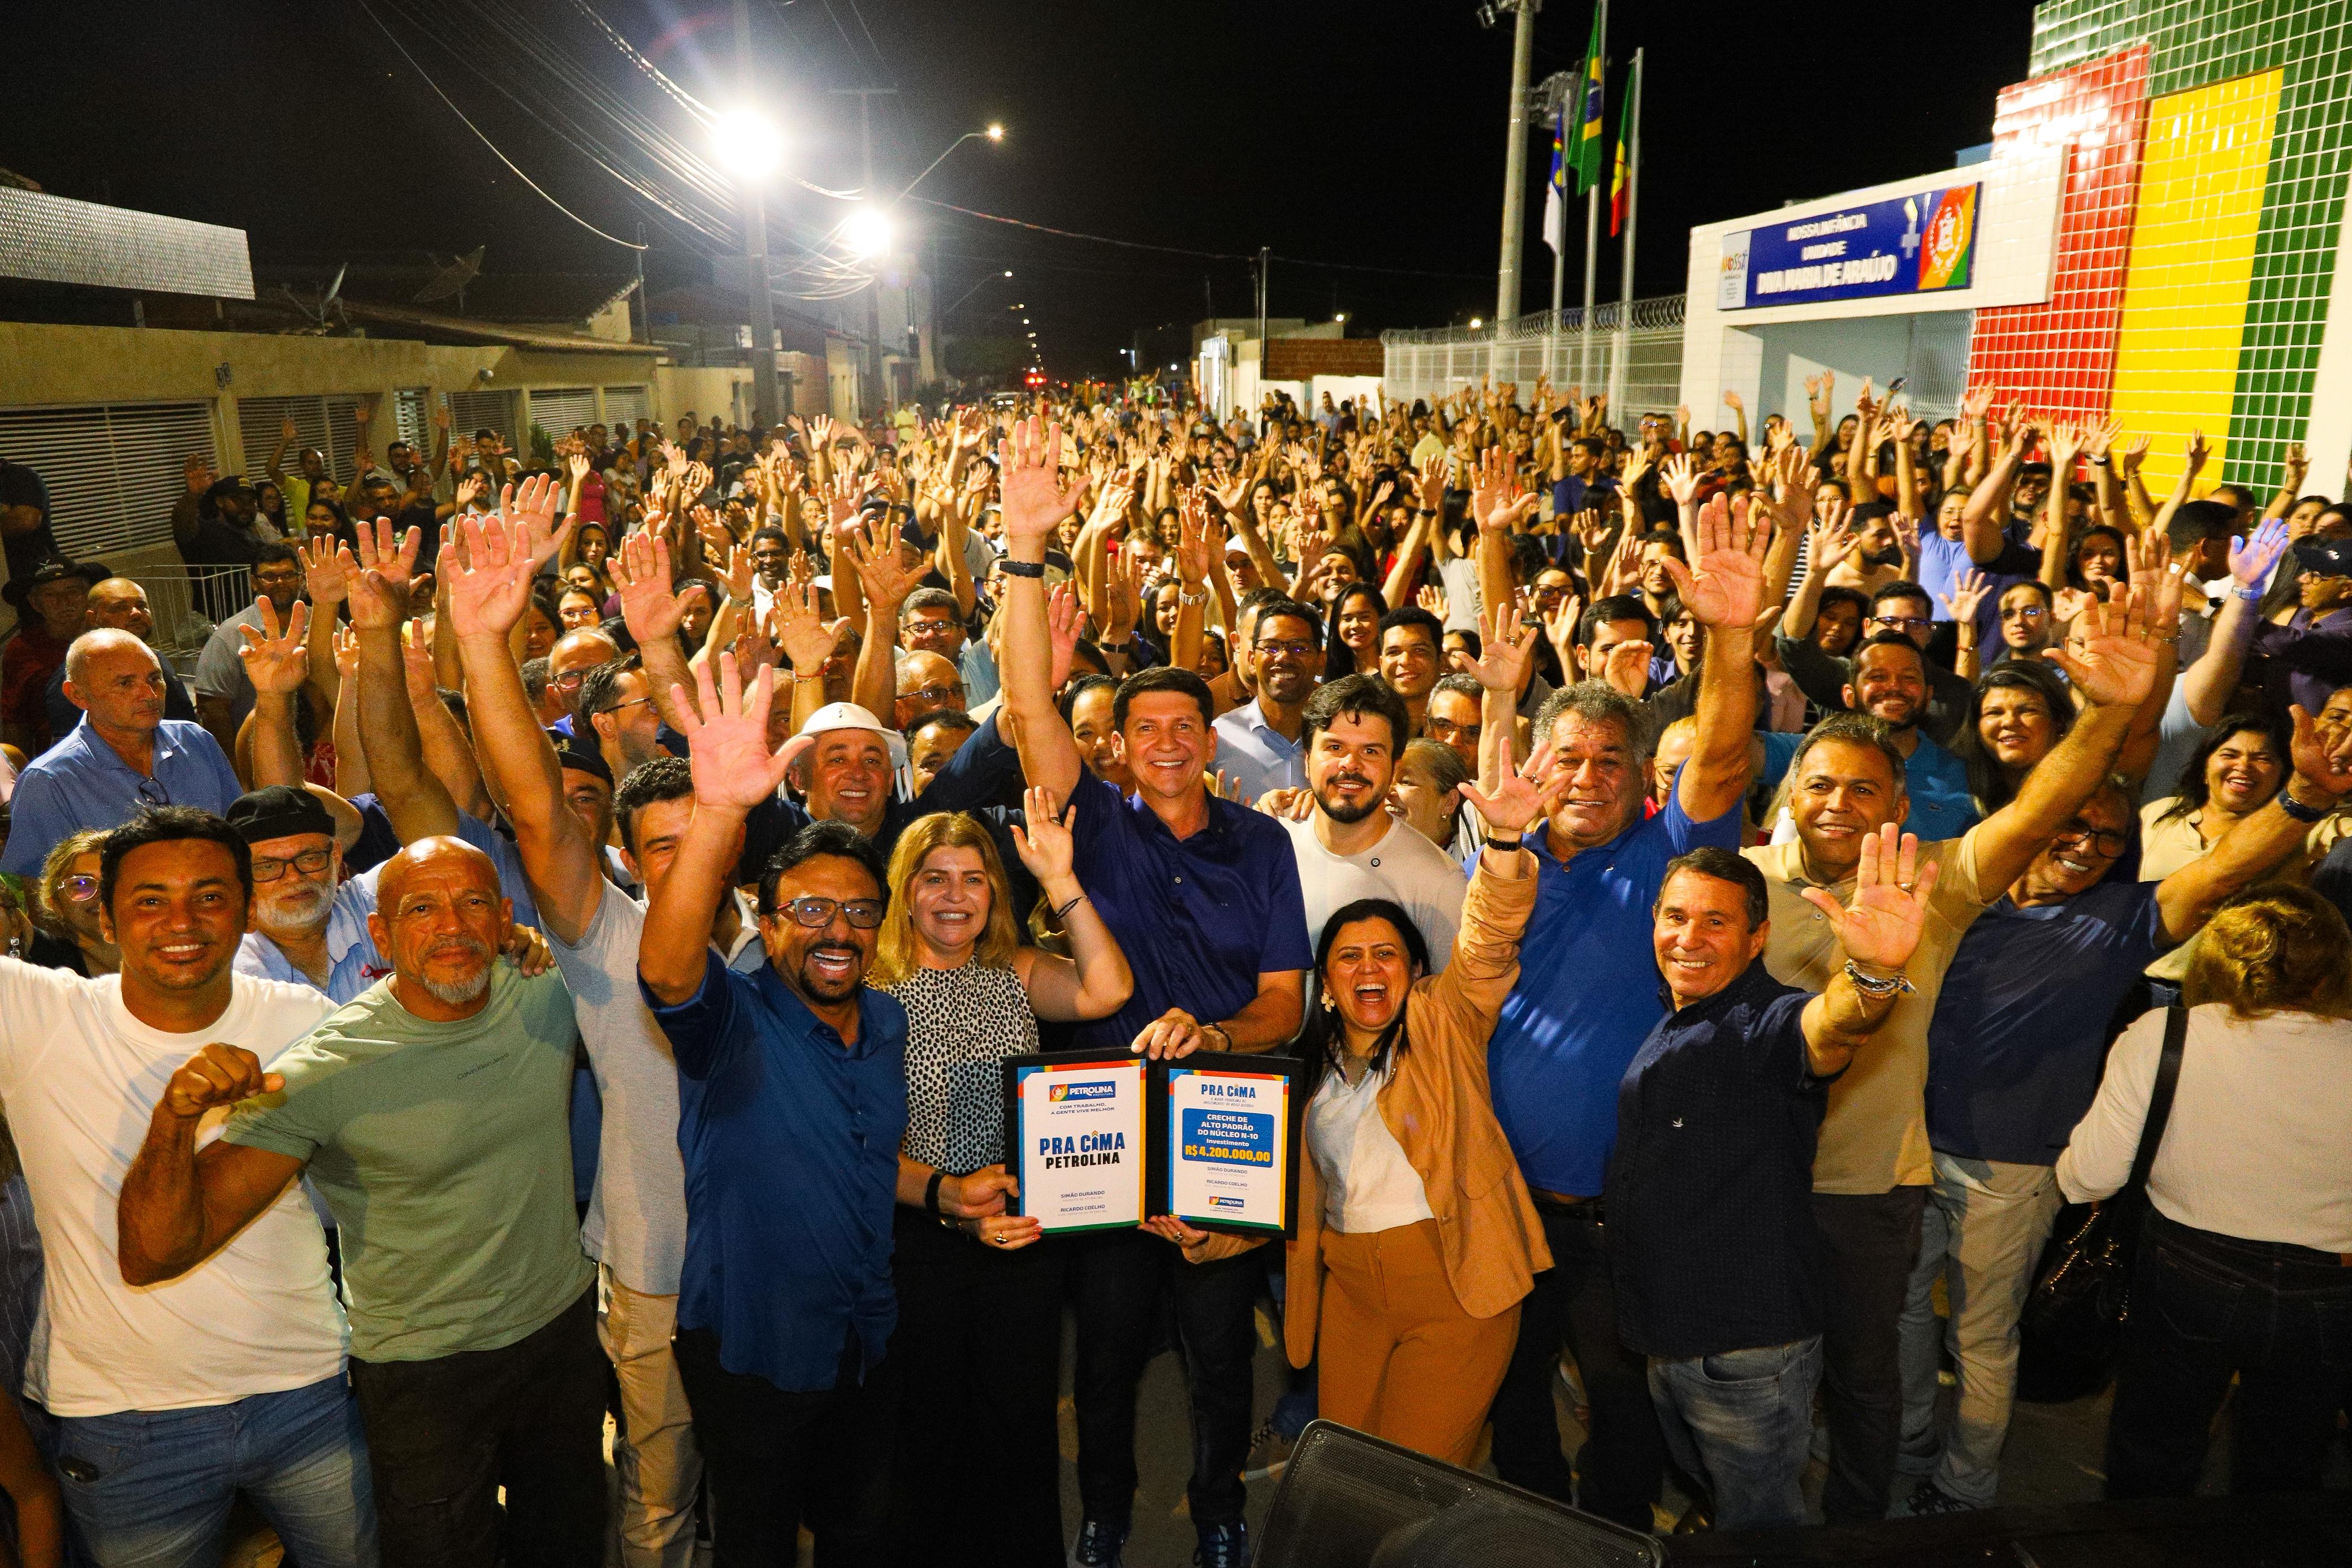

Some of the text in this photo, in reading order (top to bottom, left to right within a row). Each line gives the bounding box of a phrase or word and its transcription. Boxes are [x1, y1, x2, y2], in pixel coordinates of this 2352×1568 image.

[1787, 213, 1867, 241] NOSSA INFÂNCIA
[1801, 240, 1848, 261] UNIDADE
[1757, 270, 1785, 295] DIVA
[1784, 265, 1824, 291] MARIA
[1823, 262, 1843, 287] DE
[1841, 250, 1898, 285] ARAÚJO
[1070, 1086, 1113, 1096] PETROLINA
[1201, 1084, 1256, 1098] PRA CIMA
[1207, 1114, 1236, 1122] CRECHE
[1210, 1129, 1240, 1138] NÚCLEO
[1040, 1130, 1125, 1155] PRA CIMA
[1206, 1138, 1250, 1147] Investimento
[1046, 1152, 1120, 1169] PETROLINA
[1185, 1145, 1270, 1162] R$ 4.200.000,00
